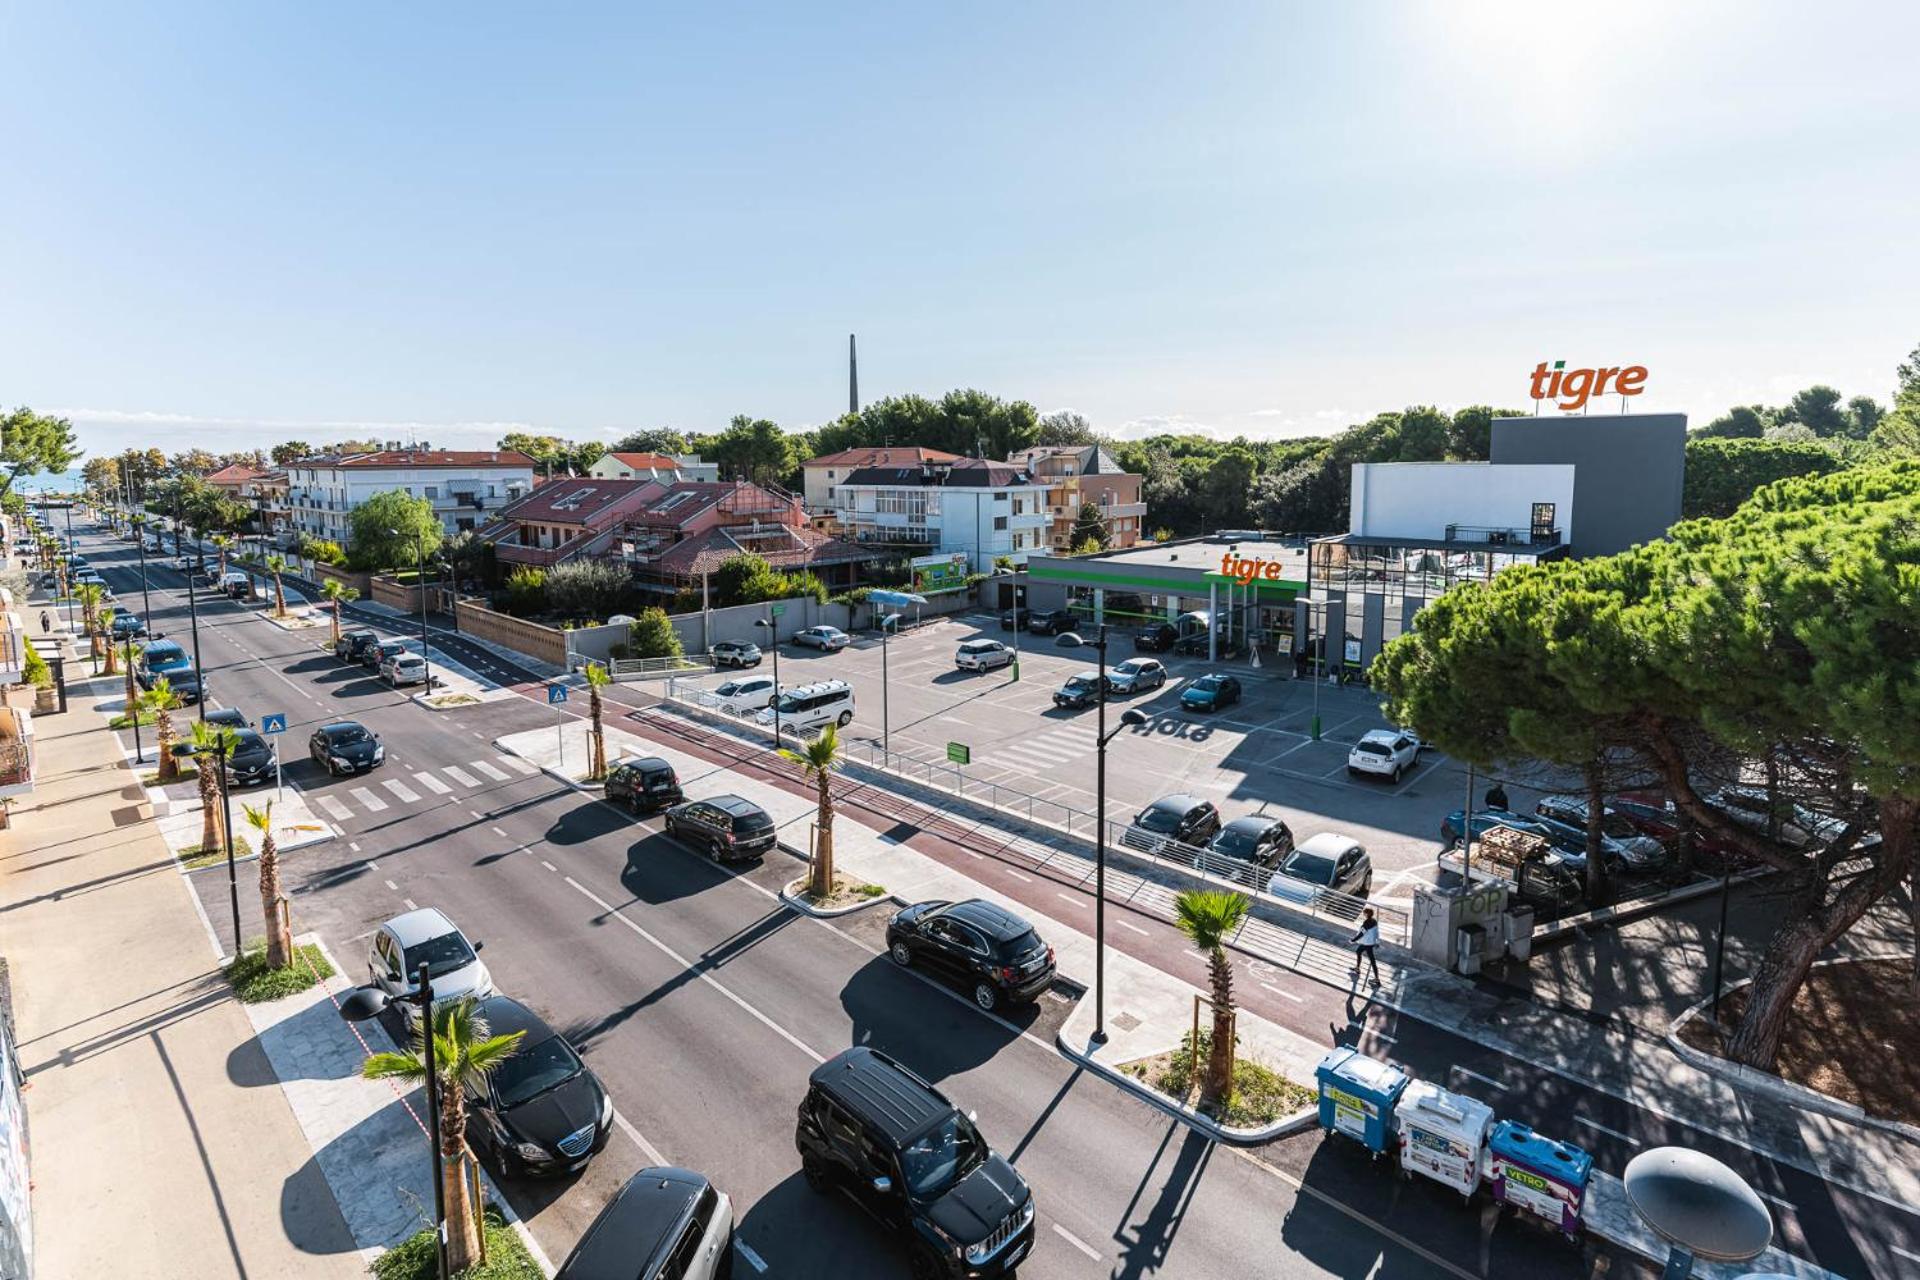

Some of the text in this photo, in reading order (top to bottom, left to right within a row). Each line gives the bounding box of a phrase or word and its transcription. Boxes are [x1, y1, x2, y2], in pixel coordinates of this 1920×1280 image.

[1530, 360, 1649, 411] tigre
[1221, 552, 1282, 586] tigre
[1508, 1167, 1545, 1189] VETRO
